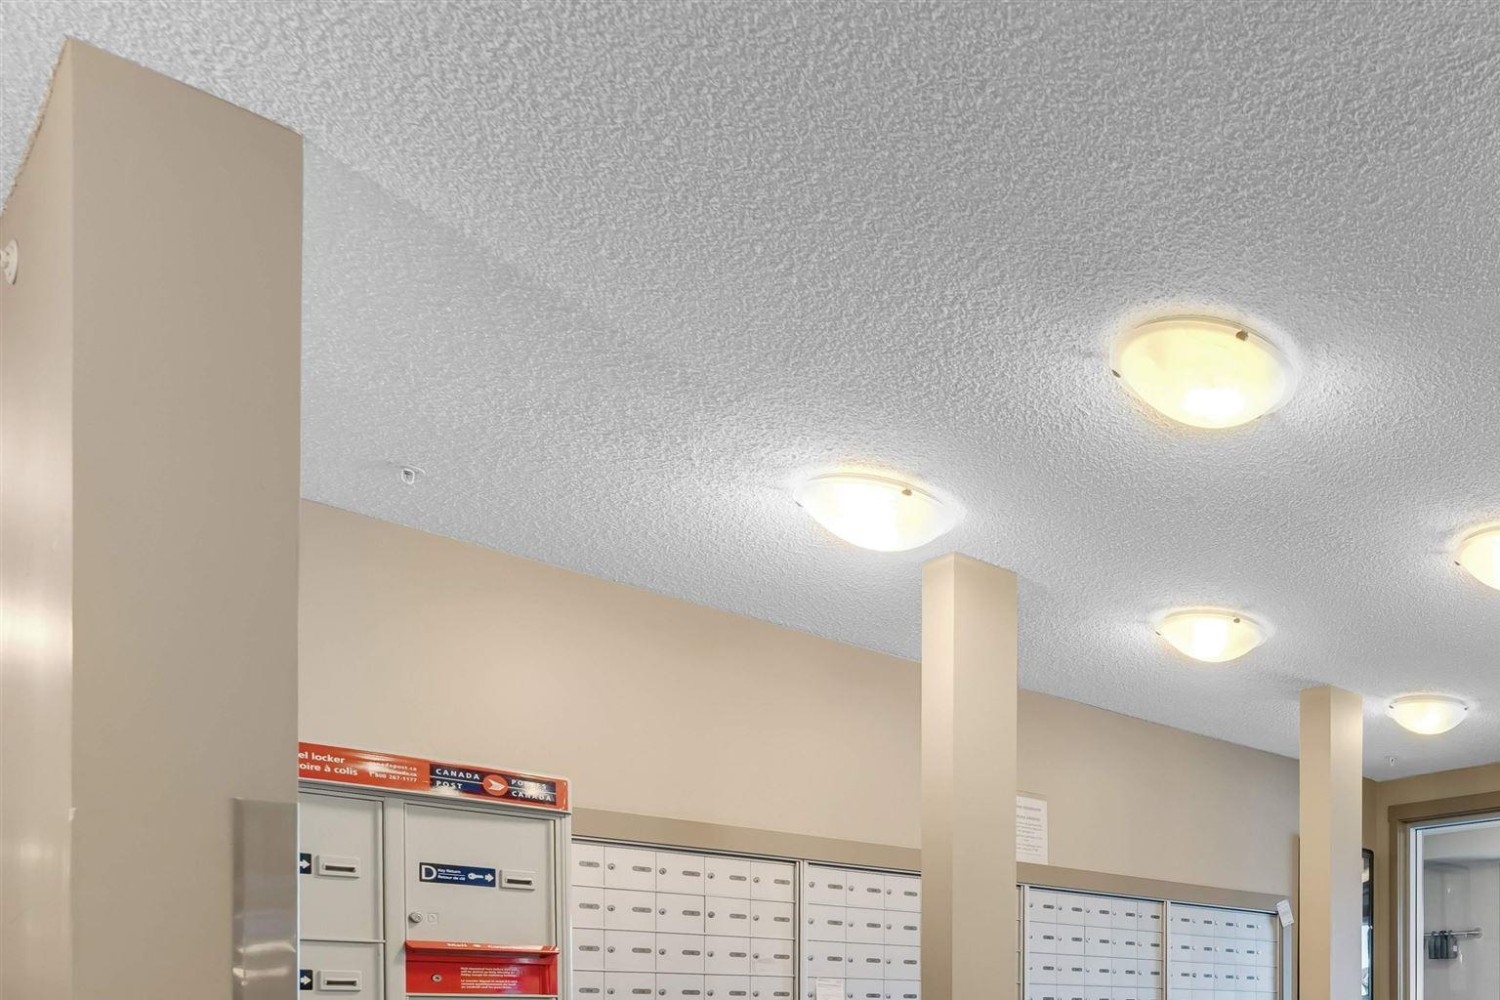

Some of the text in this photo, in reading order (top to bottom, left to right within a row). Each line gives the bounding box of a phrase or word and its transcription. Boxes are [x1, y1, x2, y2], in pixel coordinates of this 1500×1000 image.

[312, 753, 345, 763] locker
[324, 764, 331, 772] à
[334, 766, 358, 776] colis
[435, 768, 480, 780] CANADA
[436, 780, 463, 789] POST
[511, 790, 552, 801] CANADA
[421, 864, 437, 880] D
